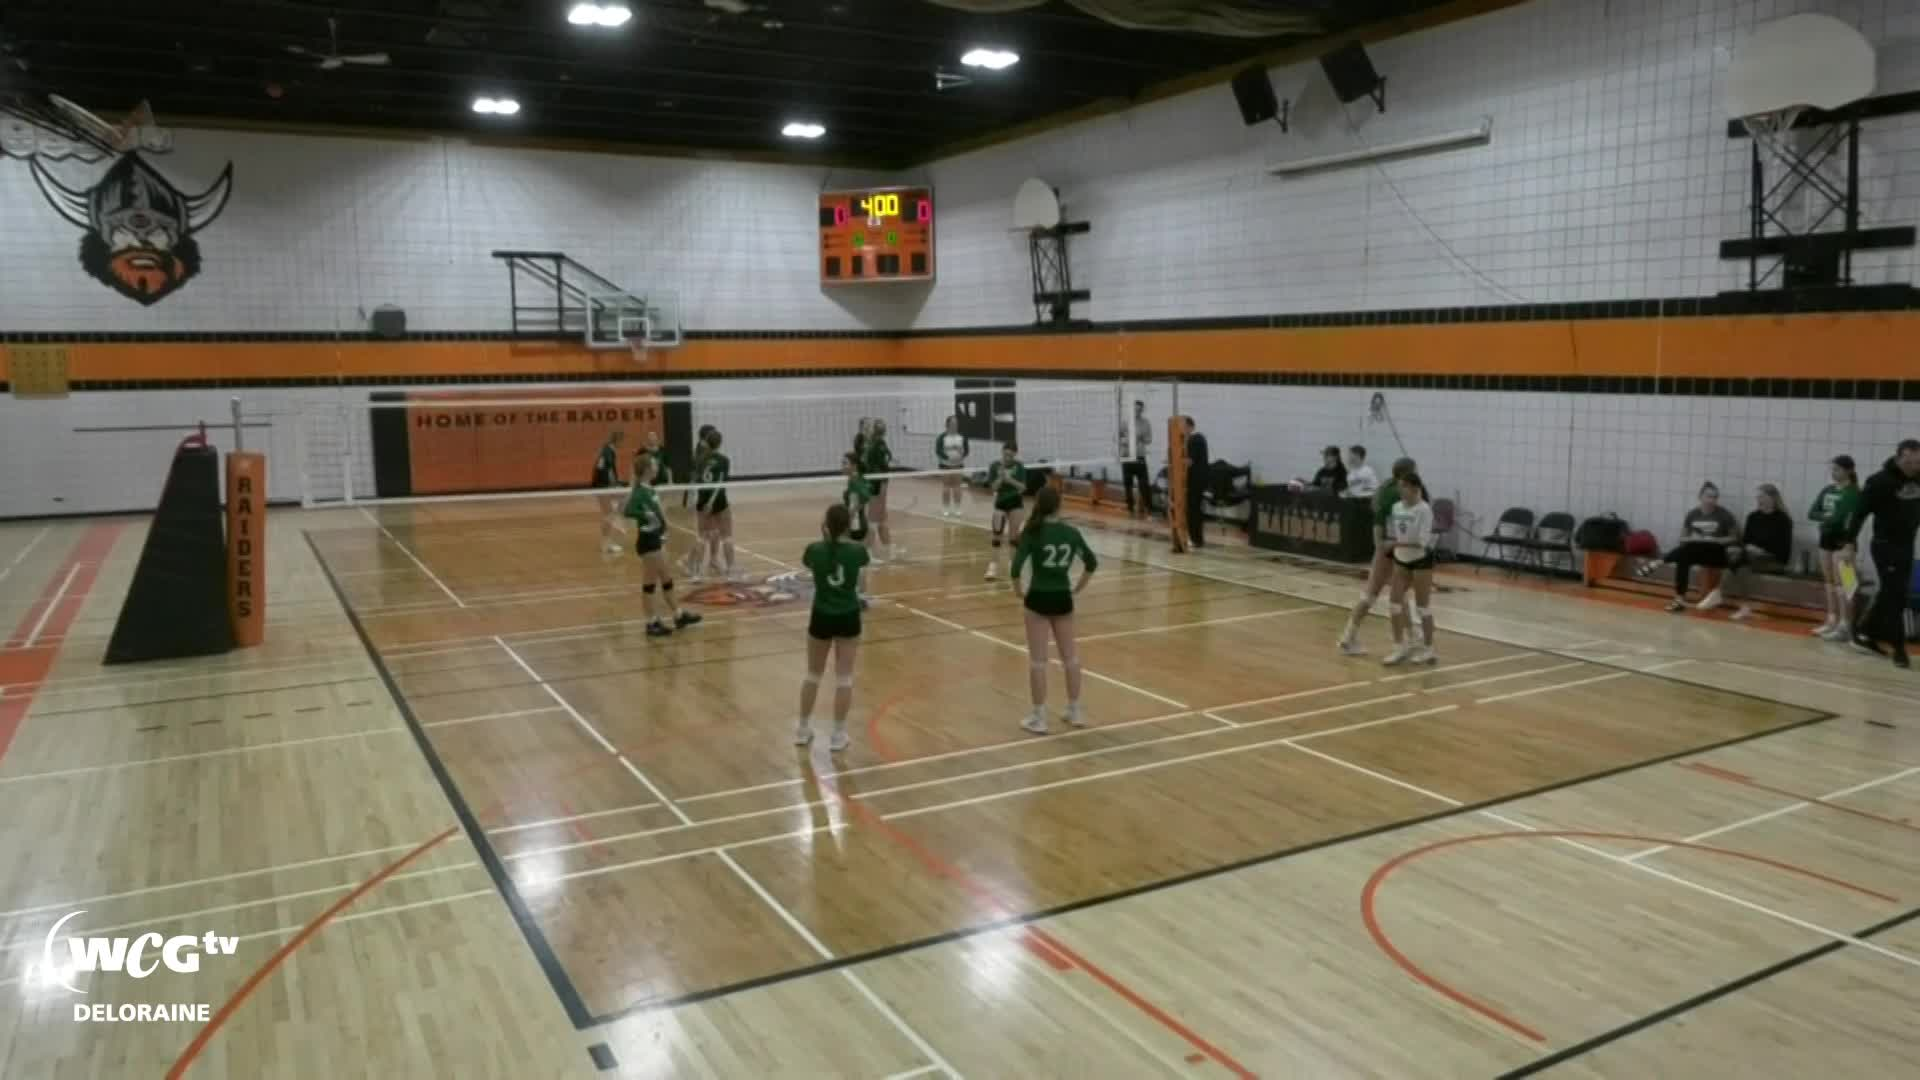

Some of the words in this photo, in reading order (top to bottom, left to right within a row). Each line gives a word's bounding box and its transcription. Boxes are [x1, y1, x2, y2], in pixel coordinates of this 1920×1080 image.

[416, 412, 485, 428] HOME
[493, 412, 517, 425] OF
[526, 410, 560, 425] THE
[566, 407, 658, 424] RAIDERS
[237, 476, 252, 617] RAIDERS
[1042, 543, 1072, 568] 22
